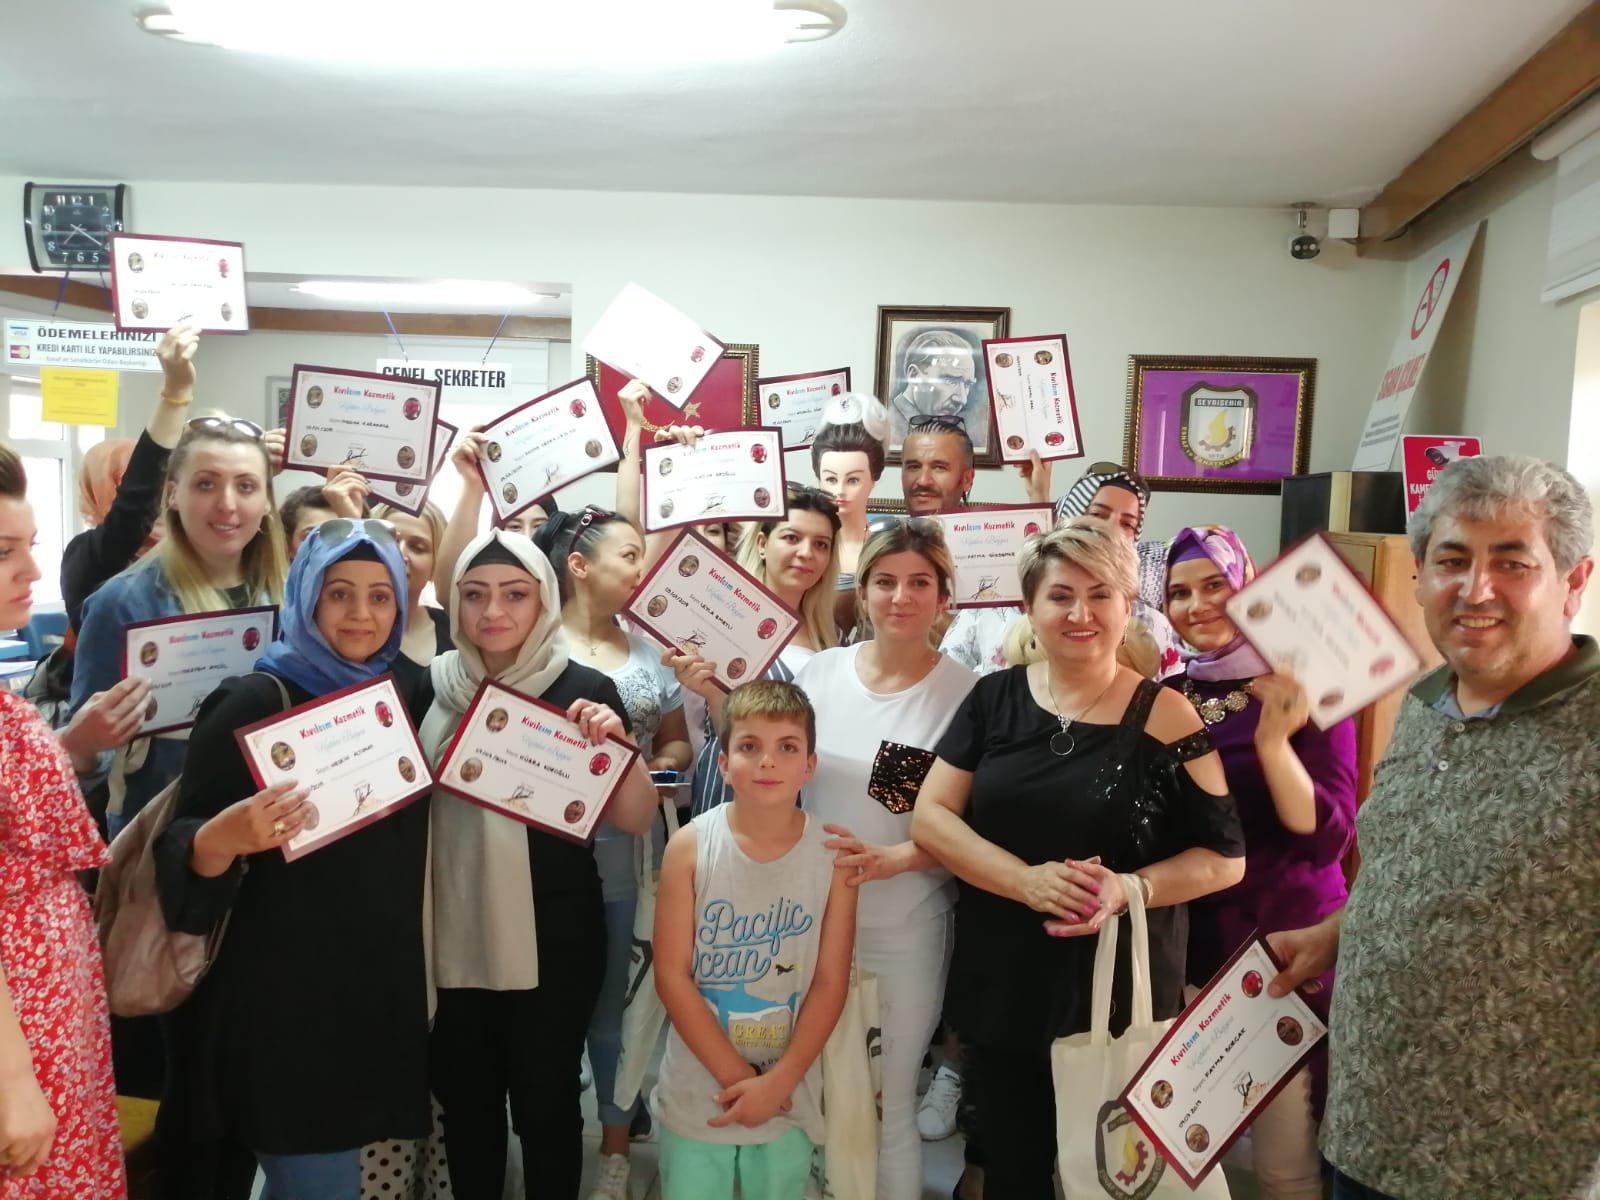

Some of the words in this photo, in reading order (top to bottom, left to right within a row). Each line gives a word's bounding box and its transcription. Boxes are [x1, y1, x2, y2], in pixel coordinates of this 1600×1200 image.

[56, 194, 66, 206] 11
[71, 194, 83, 206] 12
[88, 195, 94, 206] 1
[102, 206, 110, 216] 2
[44, 223, 52, 233] 9
[47, 241, 56, 252] 8
[62, 252, 69, 262] 7
[76, 251, 85, 263] 6
[92, 252, 100, 263] 5
[434, 368, 506, 388] SEKRETER
[733, 587, 761, 613] Kozmetik
[333, 706, 366, 726] Kozmetik
[553, 729, 589, 750] Kozmetik
[699, 896, 813, 957] Pacific
[1170, 1031, 1200, 1066] Kıvılcım
[1198, 992, 1233, 1031] Kozmetik
